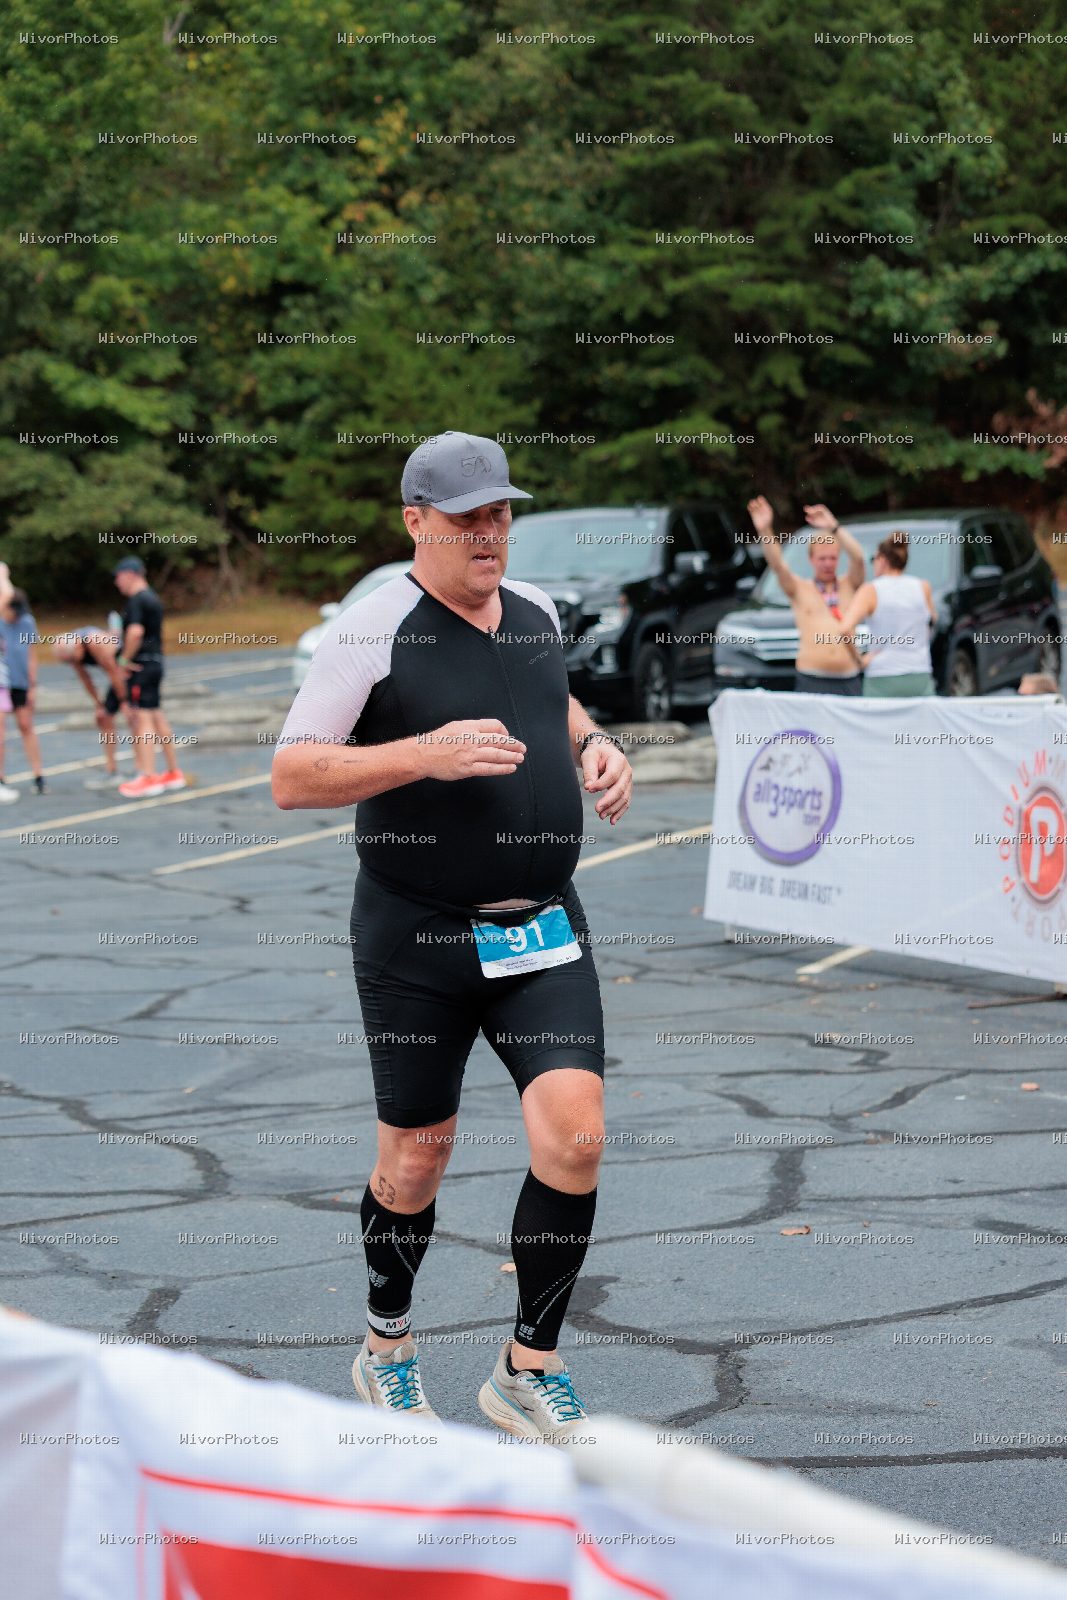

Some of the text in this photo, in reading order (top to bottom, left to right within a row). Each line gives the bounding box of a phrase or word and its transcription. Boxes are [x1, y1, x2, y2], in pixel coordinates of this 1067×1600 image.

[753, 778, 823, 818] all3sports
[727, 869, 758, 893] DREAM
[779, 878, 809, 901] DREAM
[504, 919, 545, 953] 91
[385, 1317, 410, 1329] MYL
